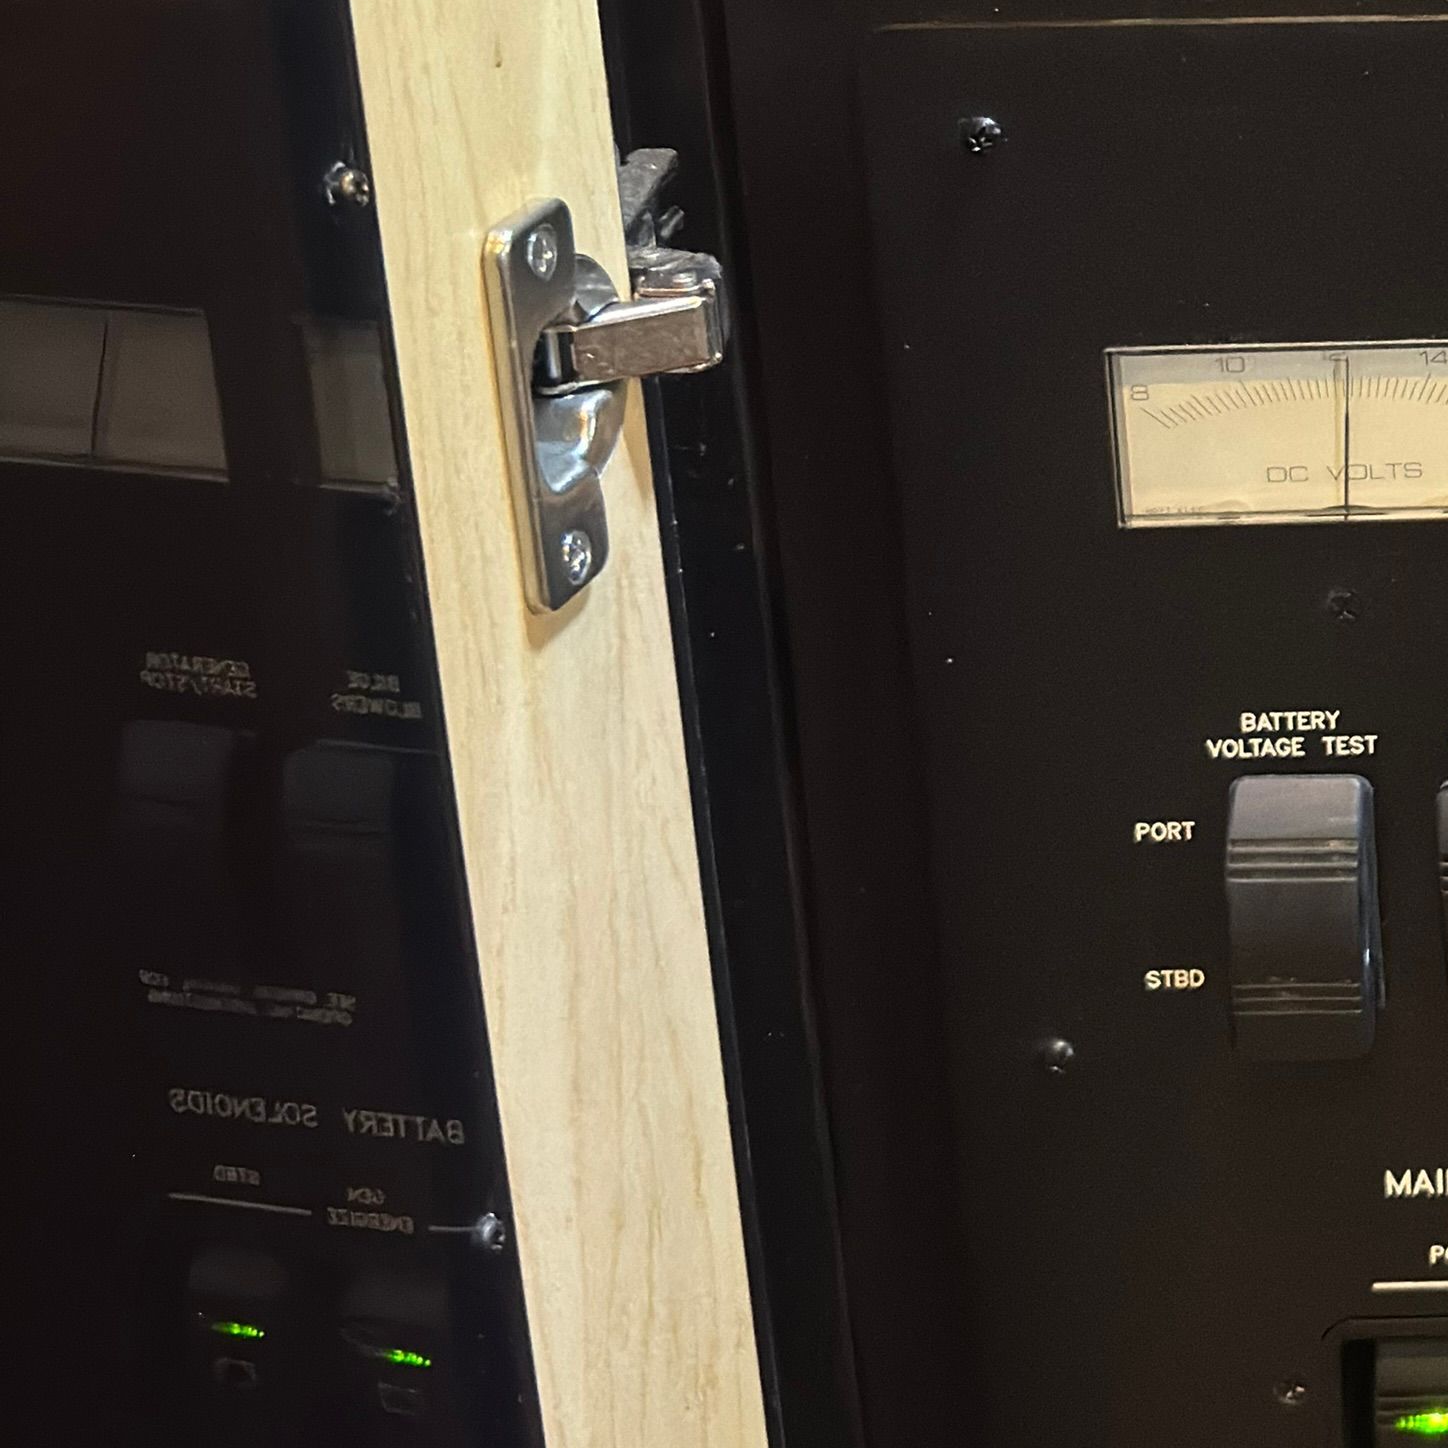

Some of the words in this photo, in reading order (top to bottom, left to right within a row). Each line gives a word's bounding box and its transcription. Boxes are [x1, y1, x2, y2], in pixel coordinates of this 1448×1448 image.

[1265, 463, 1309, 483] DC
[1326, 462, 1423, 482] VOLTS
[1241, 710, 1340, 733] BATTERY
[1206, 737, 1305, 758] VOLTAGE
[1322, 735, 1377, 755] TEST
[1135, 822, 1195, 841] PORT
[1145, 969, 1204, 989] STBD
